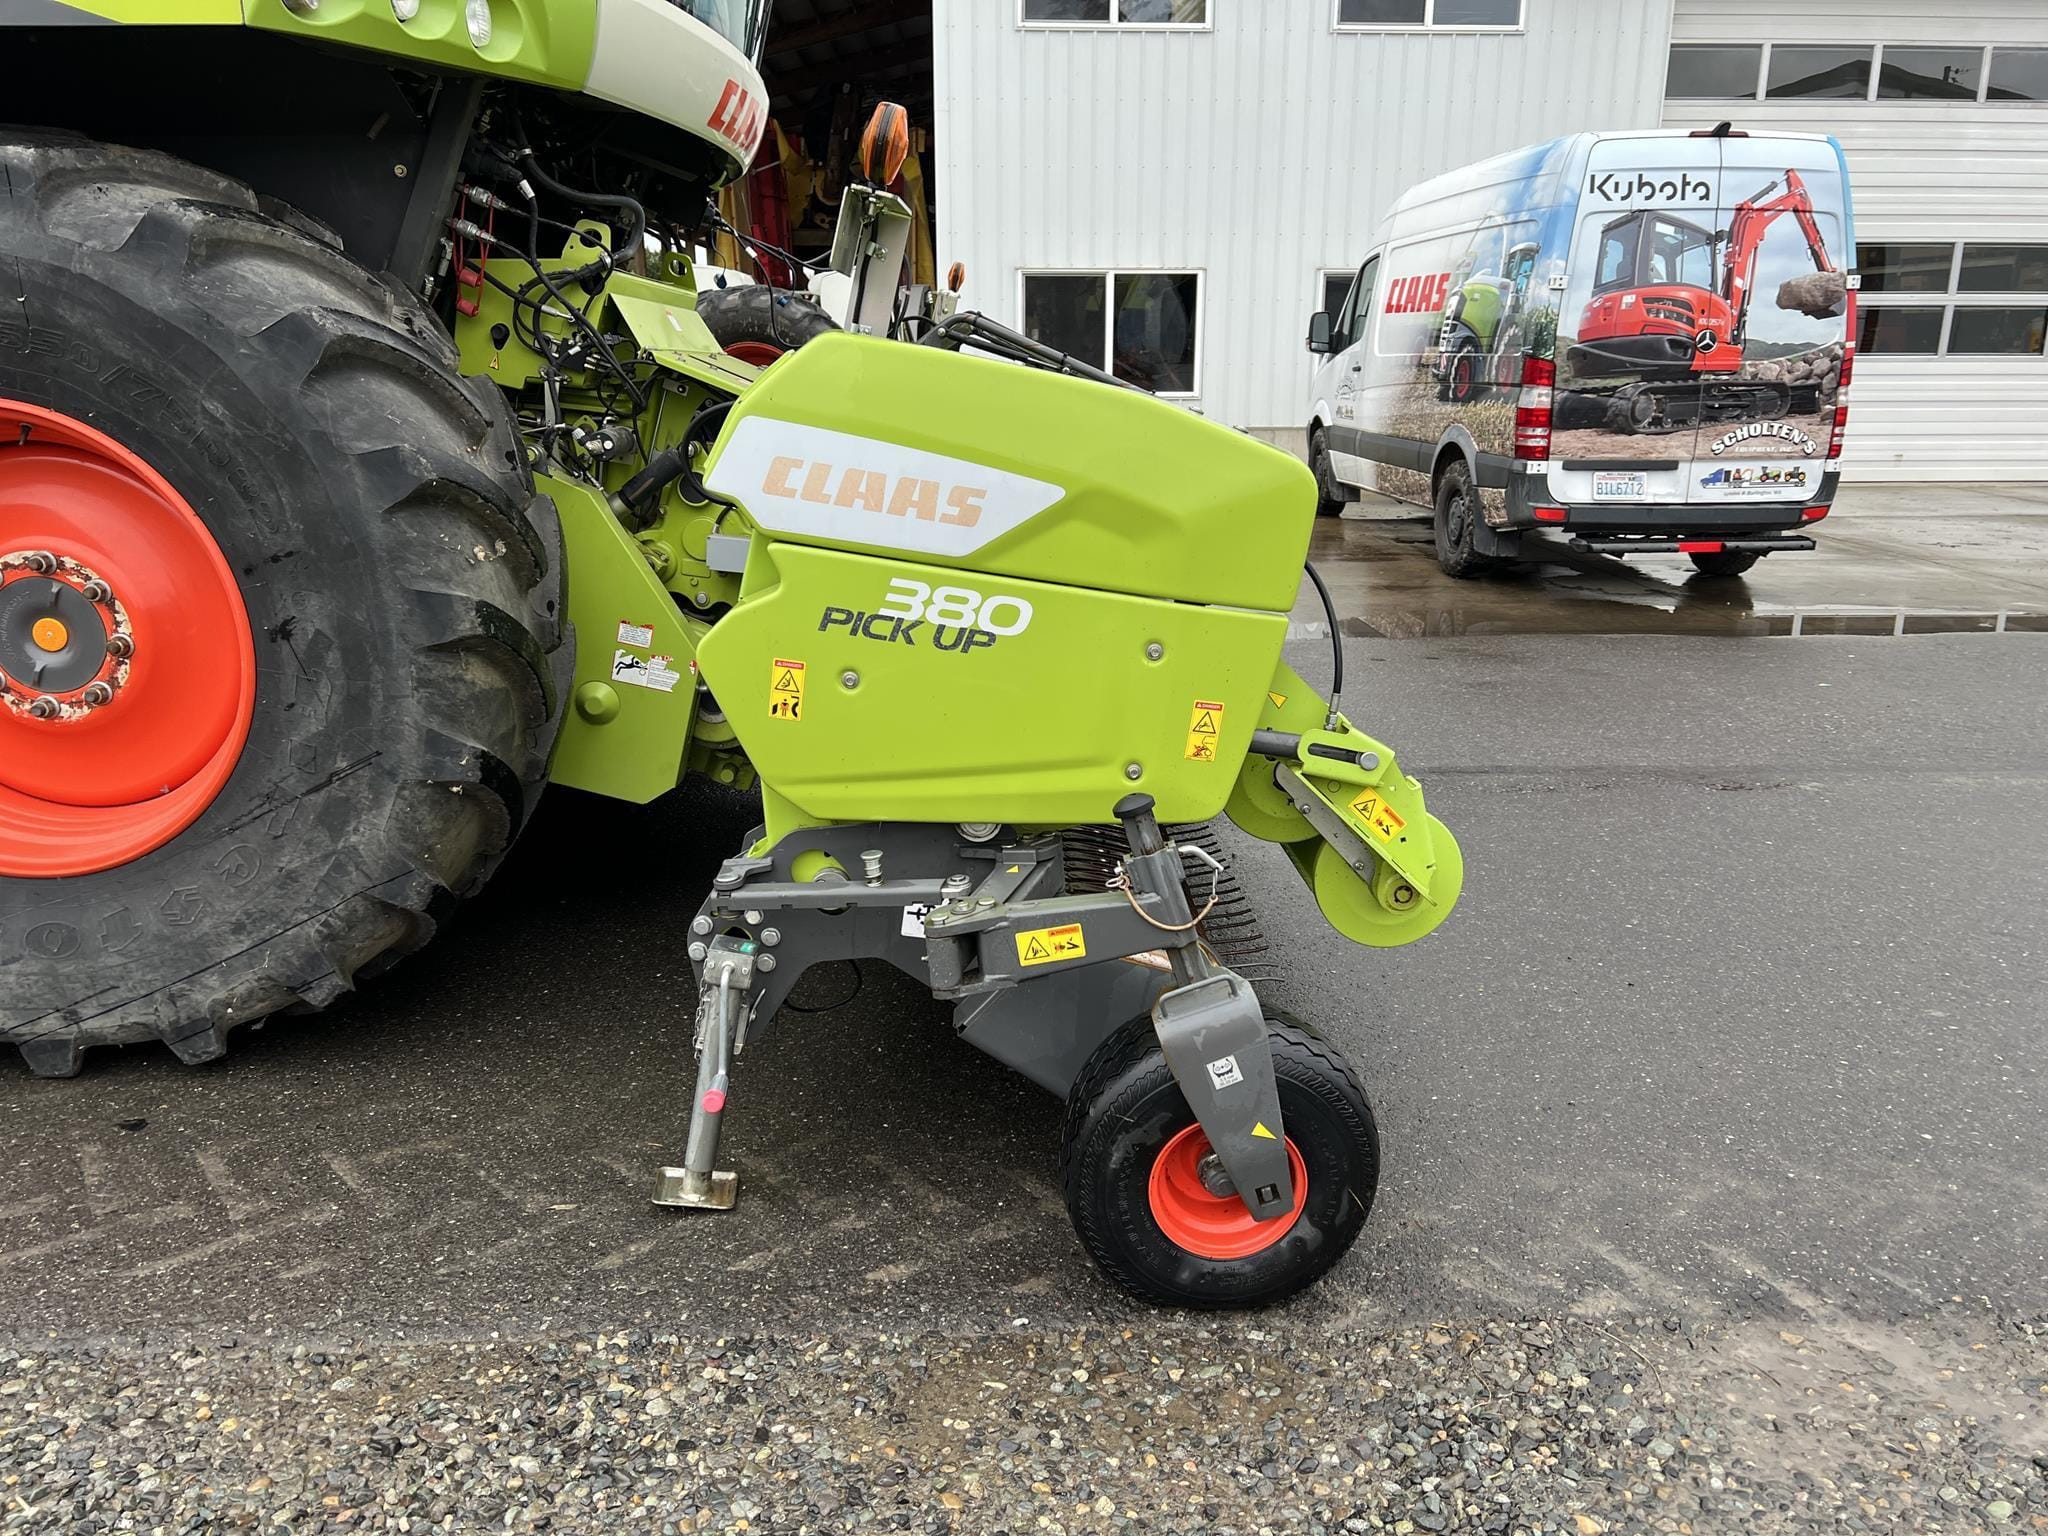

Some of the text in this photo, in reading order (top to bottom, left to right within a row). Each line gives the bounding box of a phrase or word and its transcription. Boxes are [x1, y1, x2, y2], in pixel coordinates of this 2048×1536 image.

[1589, 172, 1711, 202] Kubota
[1385, 272, 1452, 314] CLAAS
[1711, 421, 1817, 456] SCHOLTEN'S
[761, 455, 988, 528] CLAAS
[1597, 481, 1645, 496] BIL6712
[877, 577, 1034, 637] 380
[817, 605, 998, 654] PICK UP
